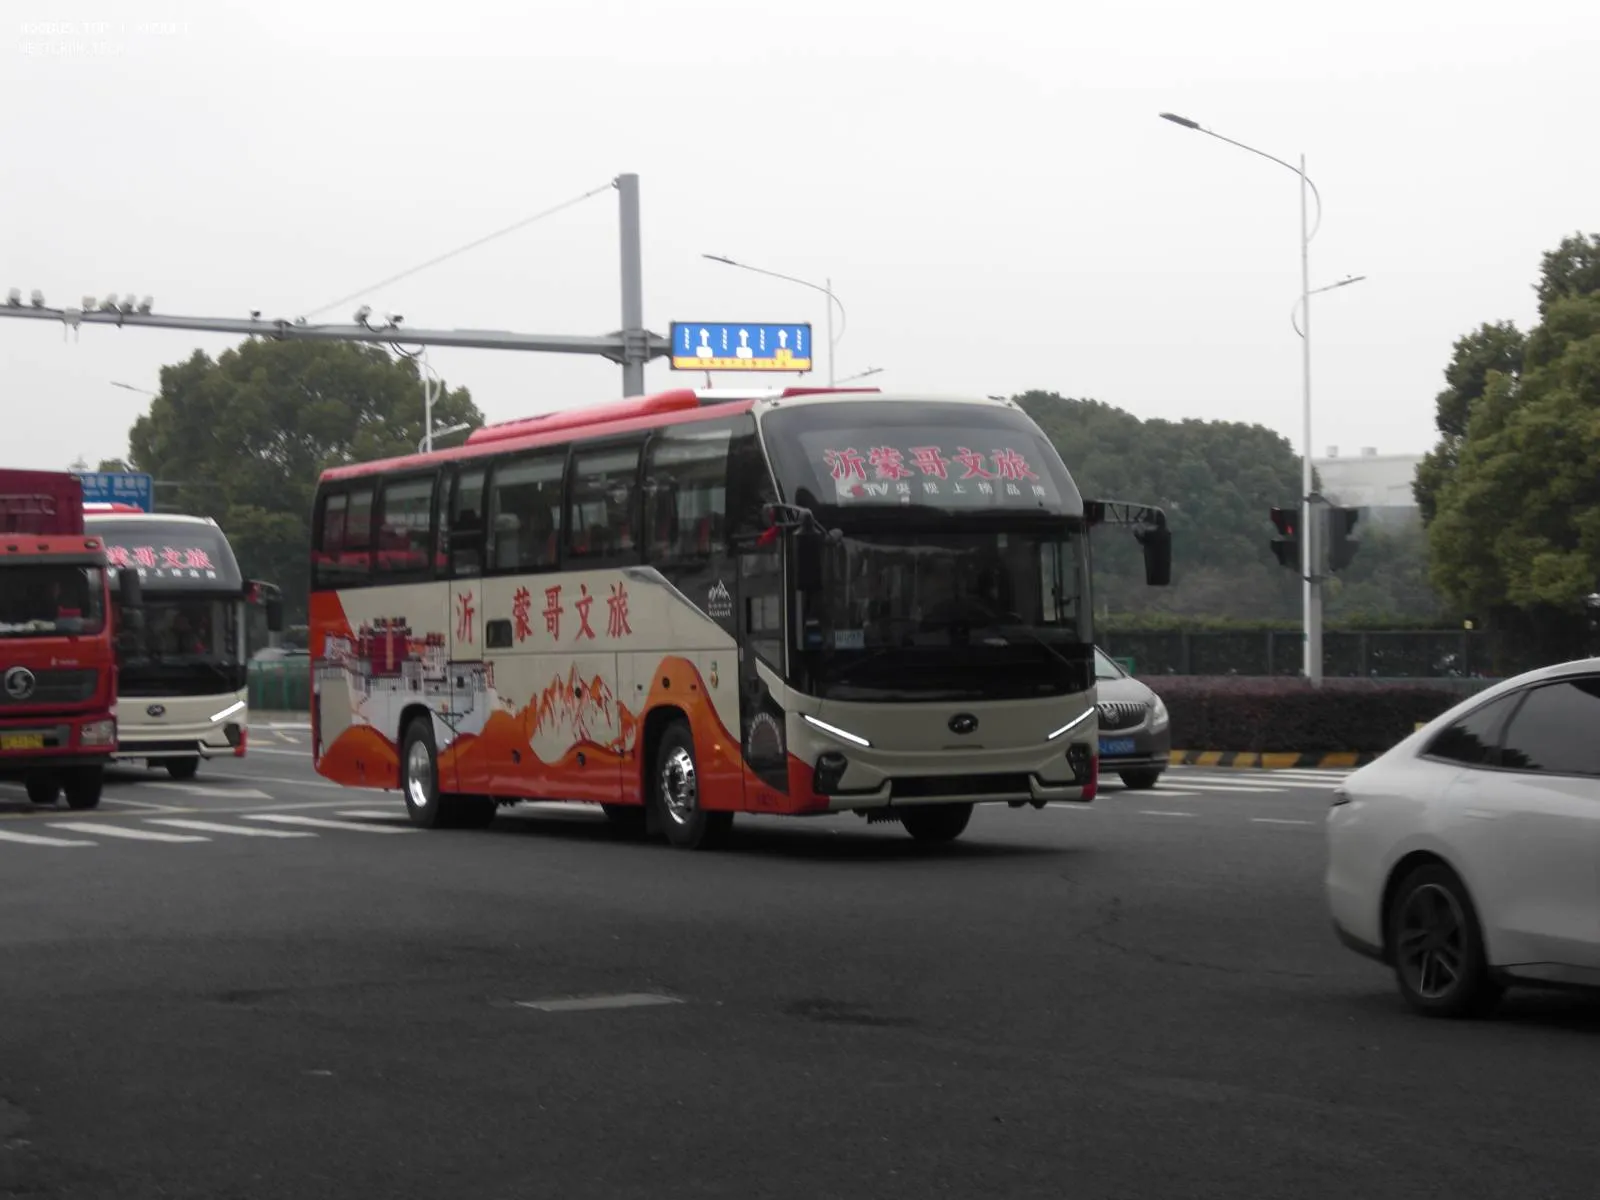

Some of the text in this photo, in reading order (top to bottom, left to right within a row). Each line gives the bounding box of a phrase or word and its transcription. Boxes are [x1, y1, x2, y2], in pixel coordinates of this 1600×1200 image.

[823, 446, 1040, 481] 沂蒙哥文旅
[457, 581, 632, 645] 沂蒙哥文旅
